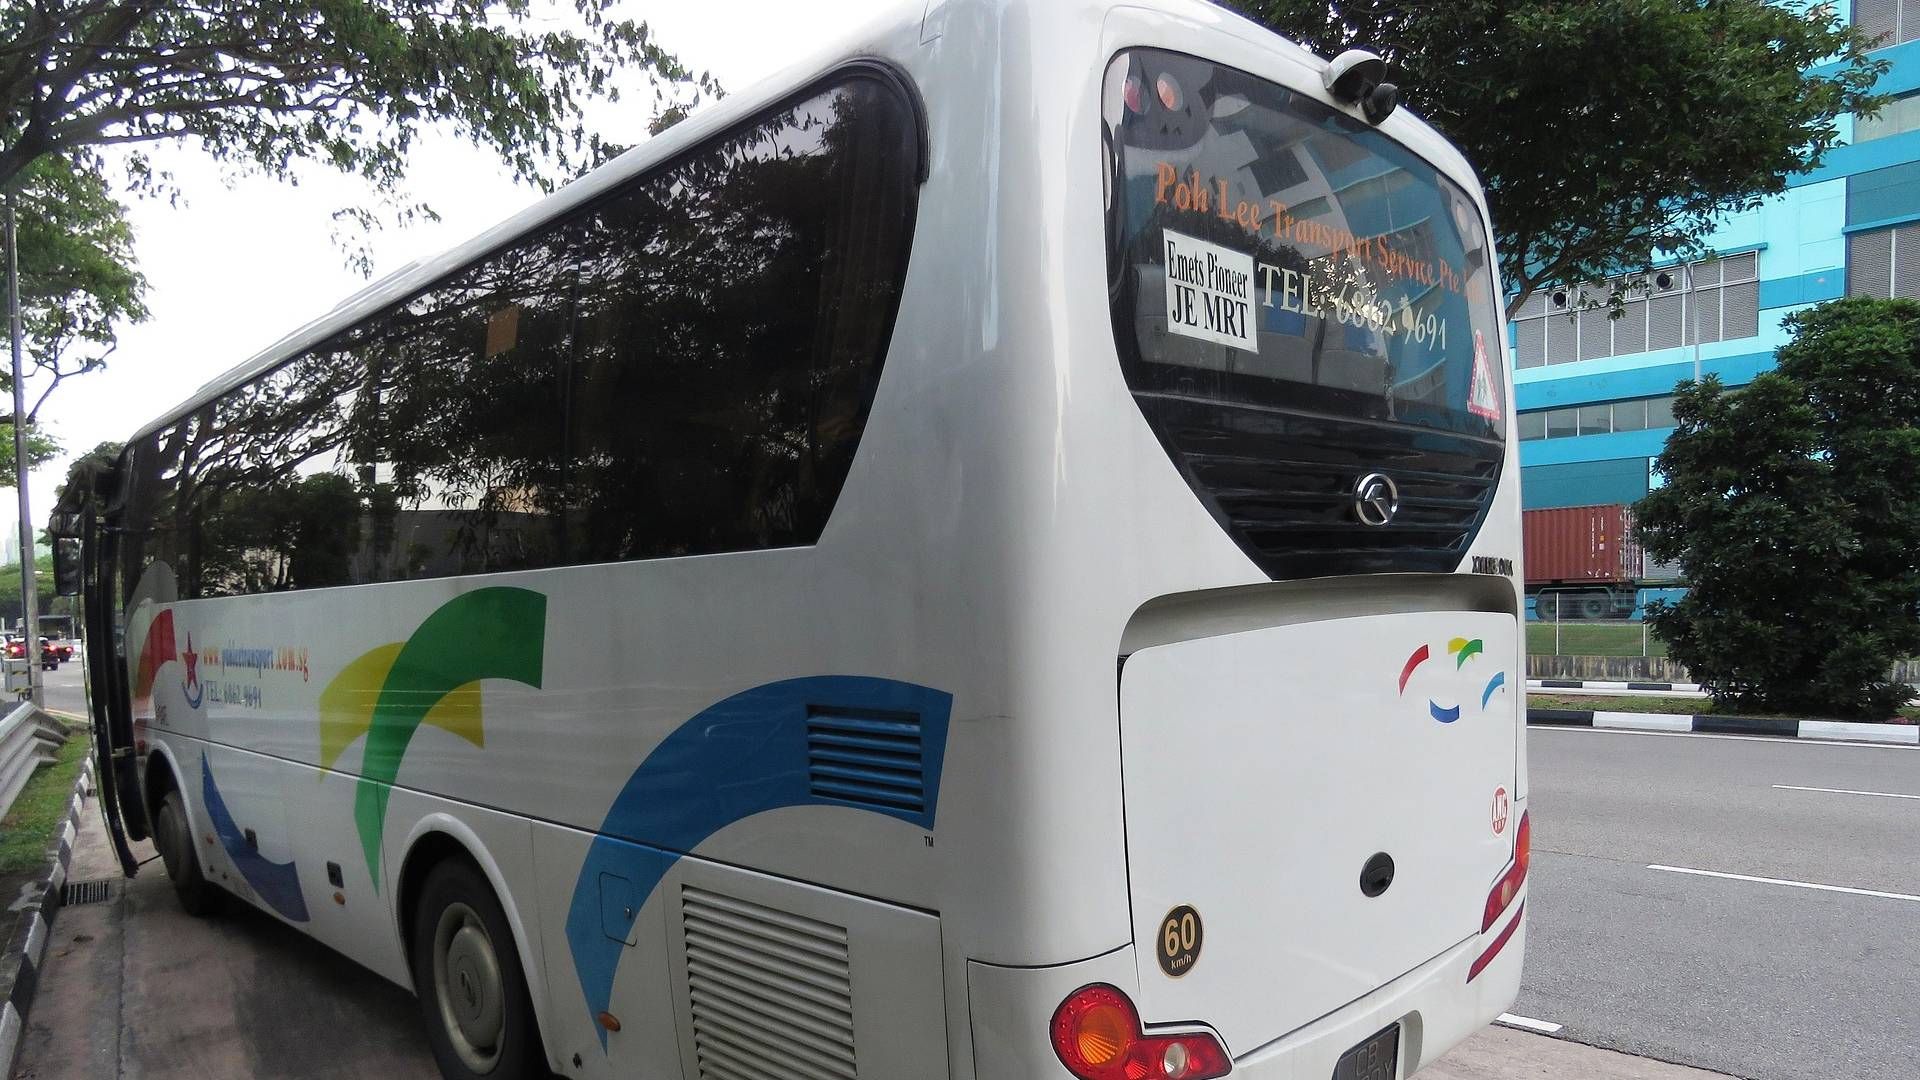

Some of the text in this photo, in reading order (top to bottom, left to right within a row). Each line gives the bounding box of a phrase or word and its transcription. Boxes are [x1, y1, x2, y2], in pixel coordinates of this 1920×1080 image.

[1156, 160, 1209, 214] Poh
[1216, 178, 1262, 231] Lee
[1270, 199, 1372, 263] Transport
[1376, 232, 1436, 286] Service
[1438, 256, 1460, 294] Pte
[1167, 239, 1249, 300] Emets Pioneer
[1172, 284, 1249, 340] JE MRT
[1335, 284, 1393, 336] 6862
[1400, 302, 1446, 351] 9691
[924, 836, 934, 848] TM
[1164, 912, 1196, 957] 60
[1171, 953, 1193, 970] km/h
